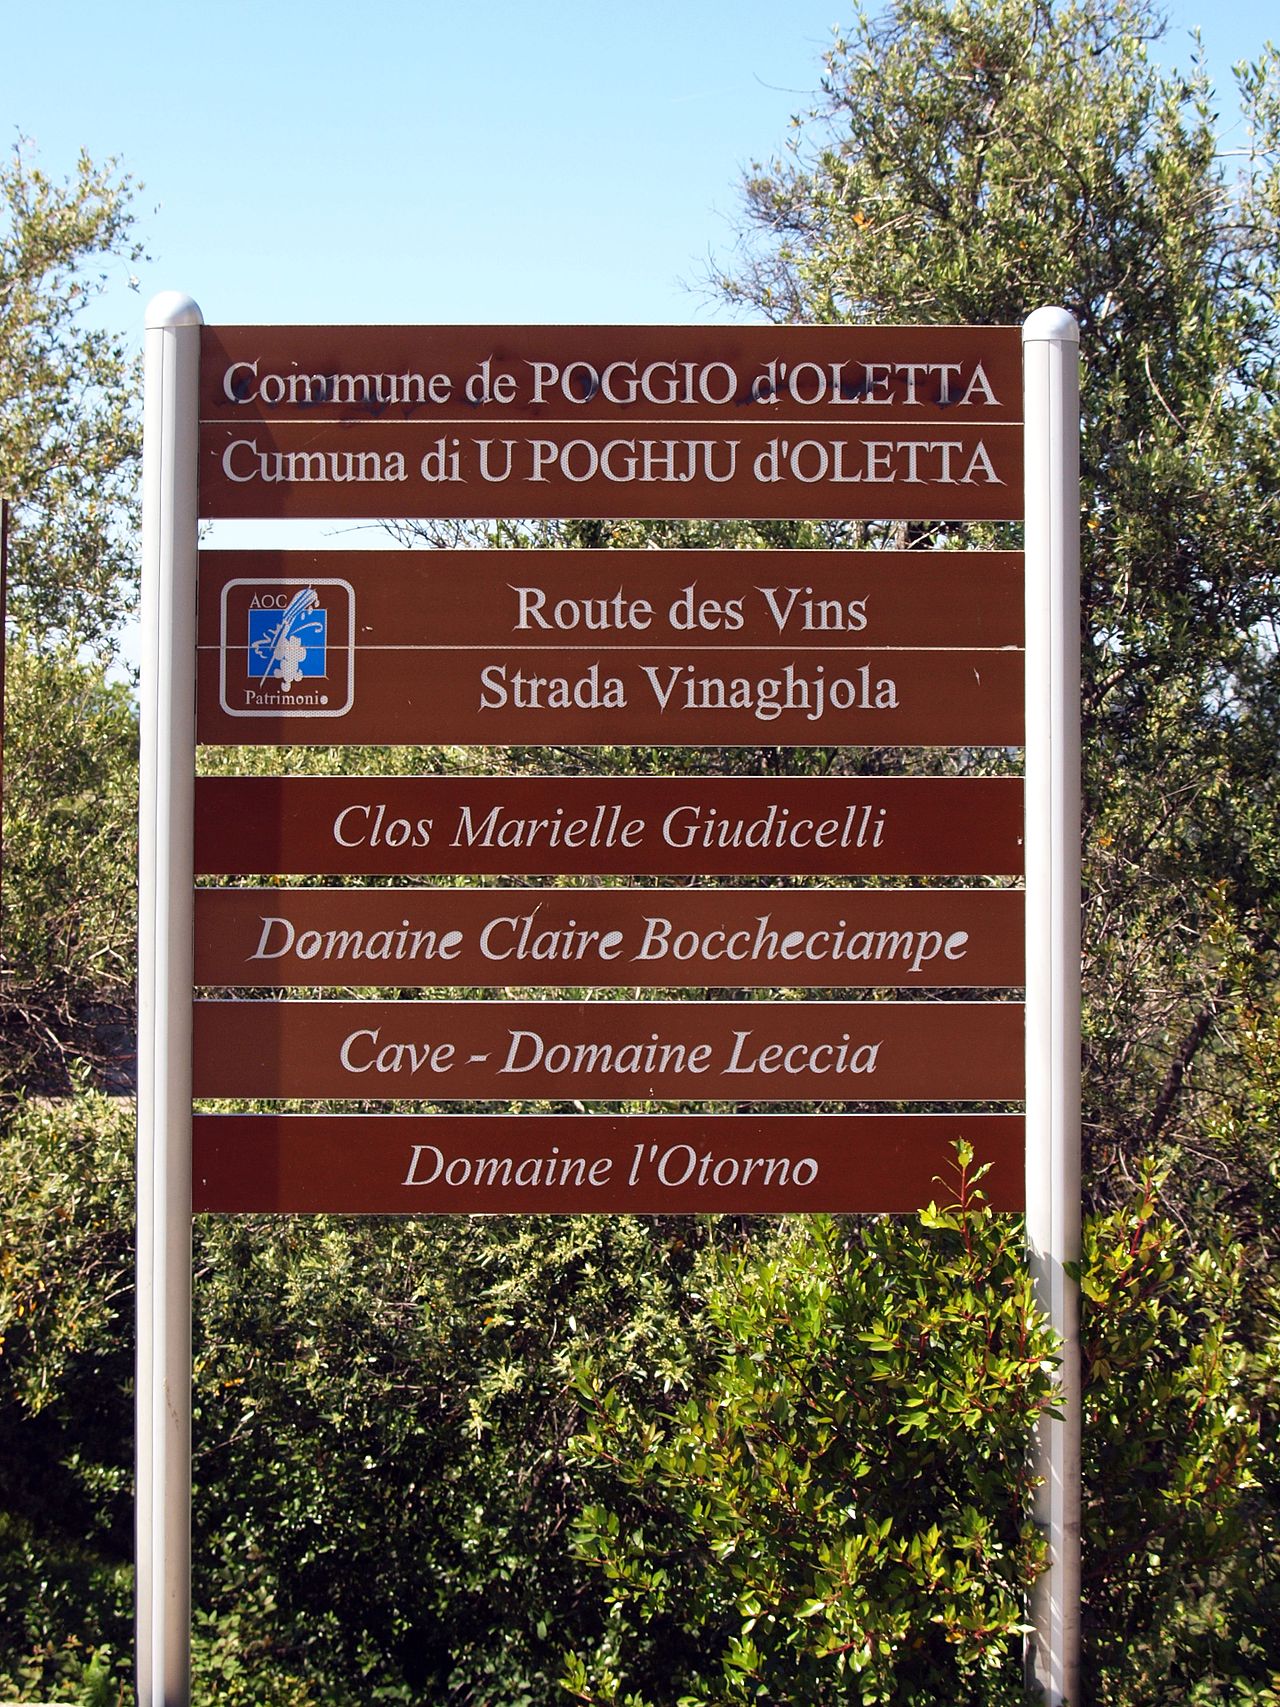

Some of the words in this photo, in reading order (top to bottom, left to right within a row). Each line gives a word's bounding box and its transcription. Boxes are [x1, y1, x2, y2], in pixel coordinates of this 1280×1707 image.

[223, 359, 451, 403] Commune
[466, 355, 517, 403] de
[524, 360, 737, 404] POGGIO
[753, 359, 1002, 405] d'OLETTA
[223, 440, 408, 481] Cumuna
[421, 436, 464, 482] di
[472, 439, 517, 481] U
[525, 439, 740, 482] POGHJU
[754, 439, 1006, 486] d'OLETTA
[249, 593, 288, 609] AOC
[507, 584, 655, 630] Route
[669, 583, 745, 630] des
[755, 587, 869, 632] Vins
[244, 690, 329, 706] Patrimonio
[479, 663, 627, 711] Strada
[639, 663, 899, 720] Vinaghjola
[334, 805, 432, 846] Clos
[449, 805, 644, 847] Marielle
[663, 805, 886, 847] Giudicelli
[247, 918, 463, 960] Domaine
[480, 910, 623, 960] Claire
[631, 914, 968, 971] Boccheciampe
[340, 1028, 455, 1073] Cave
[498, 1030, 712, 1073] Domaine
[721, 1031, 883, 1074] Leccia
[402, 1146, 612, 1186] Domaine
[629, 1144, 818, 1186] l'Otorno
